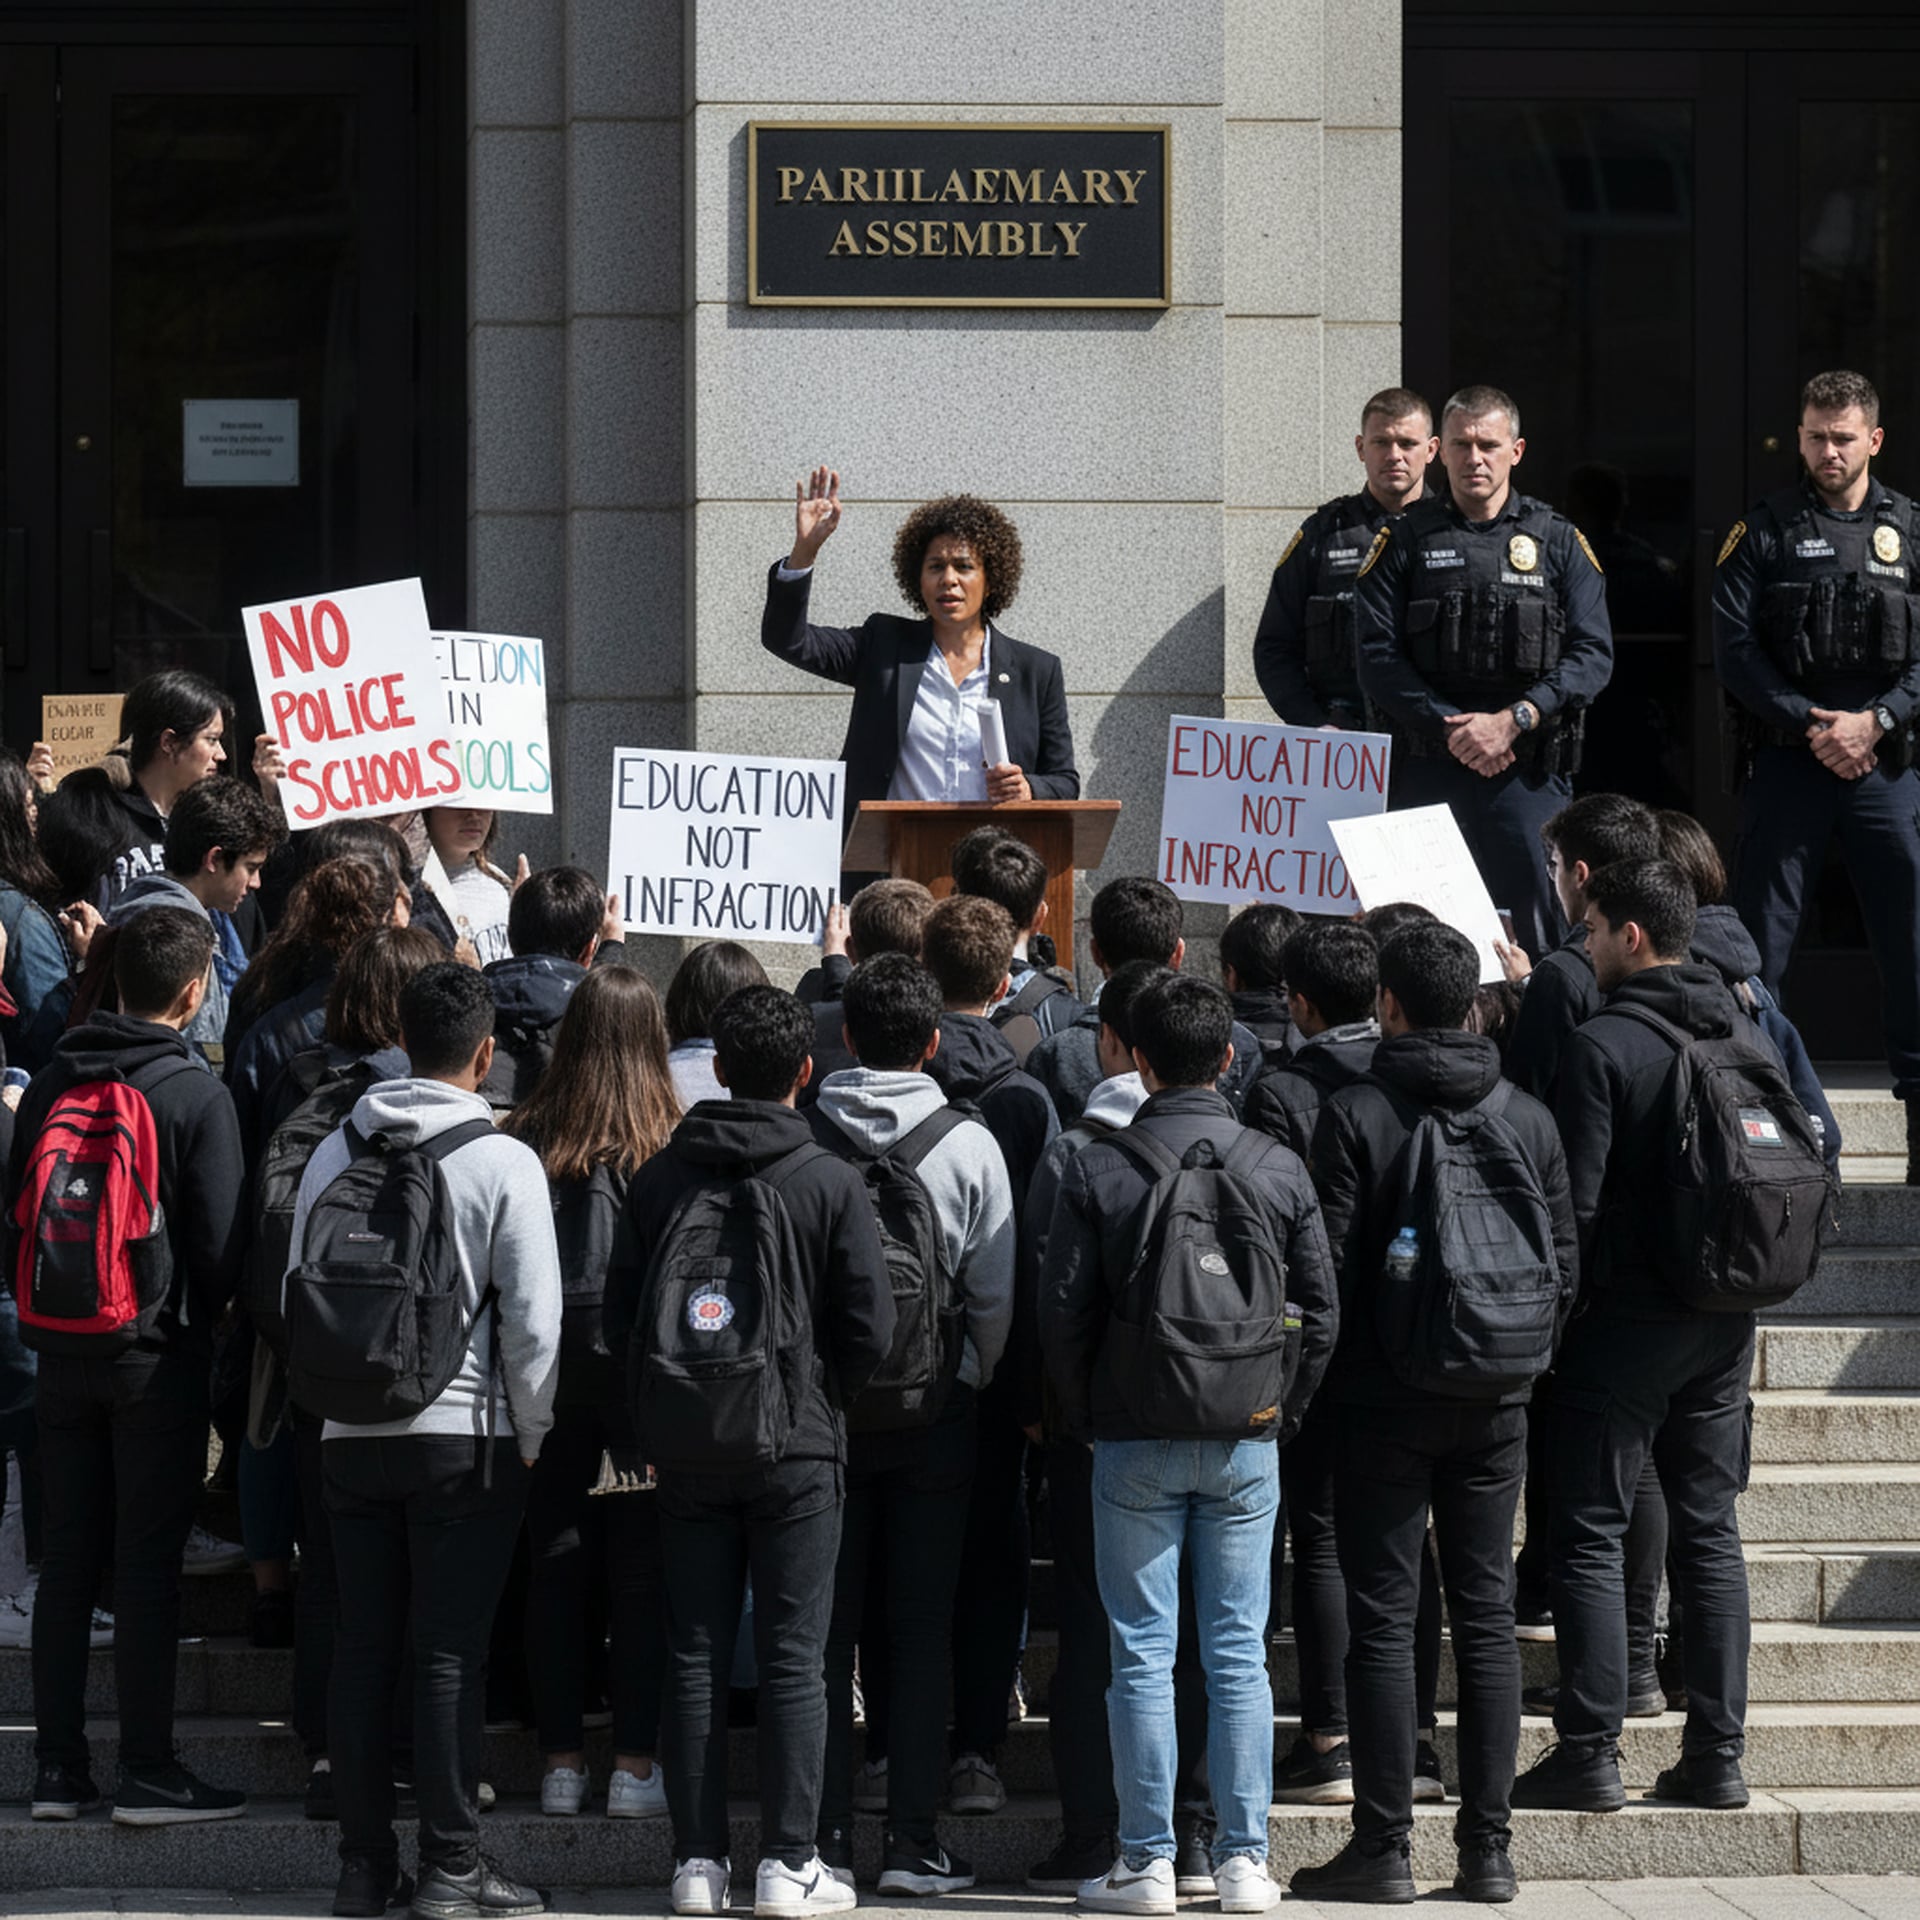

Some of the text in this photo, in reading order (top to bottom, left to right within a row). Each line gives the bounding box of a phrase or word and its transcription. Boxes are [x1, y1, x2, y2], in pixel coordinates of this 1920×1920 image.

[828, 220, 1088, 258] ASSEMBLY
[259, 599, 351, 679] NO
[448, 690, 483, 727] IN
[287, 738, 463, 821] SCHOOLS
[618, 757, 836, 821] EDUCATION
[1171, 726, 1387, 794] EDUCATION
[1240, 793, 1306, 838] NOT
[686, 824, 762, 870] NOT
[1163, 836, 1359, 902] INFRACTIO
[623, 874, 836, 934] INFRACTION
